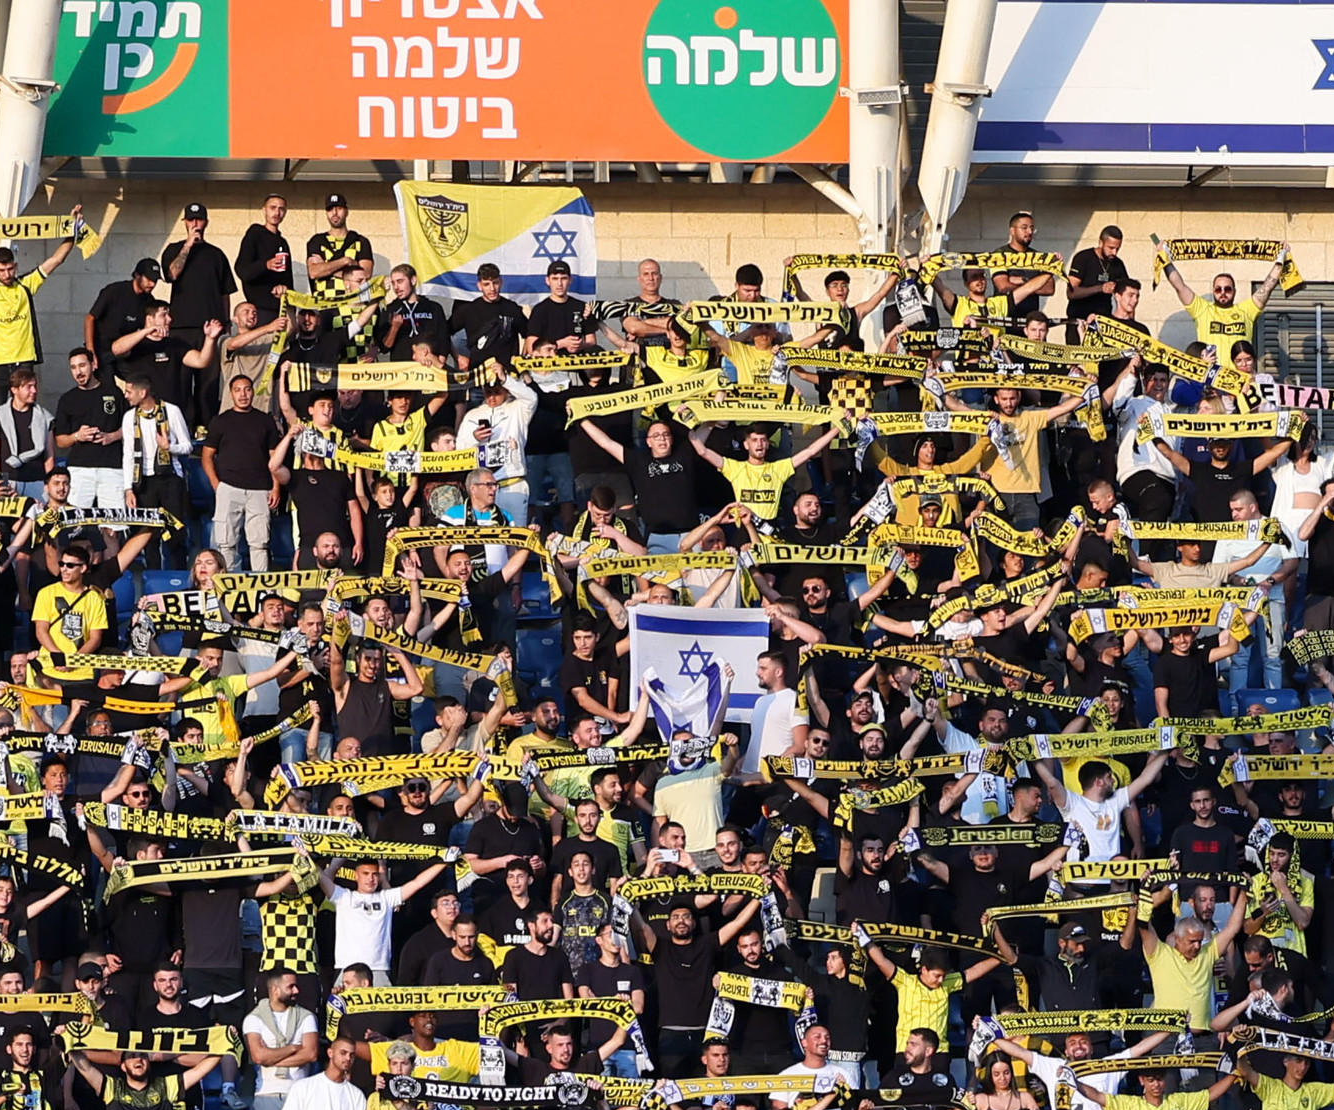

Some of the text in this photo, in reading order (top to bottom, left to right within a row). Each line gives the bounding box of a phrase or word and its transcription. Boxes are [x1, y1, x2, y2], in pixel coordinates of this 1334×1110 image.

[63, 1, 200, 38] תמיד
[351, 26, 520, 79] שלמה
[647, 29, 836, 86] שלמה
[104, 43, 154, 91] כן
[358, 96, 517, 138] ביטוח
[697, 303, 833, 321] בית"ר ירושלים
[352, 370, 435, 383] בית"ר ירושלים
[679, 379, 705, 394] אוהב
[620, 393, 639, 406] אני
[1169, 420, 1271, 433] בית"ר ירושלים
[1134, 521, 1184, 534] ירושלים
[1193, 522, 1244, 534] JERUSALEM
[774, 546, 866, 562] ירושלים
[593, 553, 734, 573] בית"ר ירושלים
[222, 572, 311, 588] ירושלים
[1114, 608, 1210, 630] בית"ר ירושלים
[1052, 740, 1102, 753] ירושלים
[1110, 735, 1157, 750] JERUSALEM
[120, 812, 186, 833] JERUSALEM
[240, 812, 358, 835] LA FAMILIA
[1273, 820, 1332, 835] ירושלים
[951, 826, 1033, 842] Jerusalem
[160, 857, 271, 876] בית"ר ירושלים
[867, 922, 936, 939] ירושלים
[1259, 1030, 1291, 1051] LA
[427, 1083, 556, 1101] READY TO FIGHT
